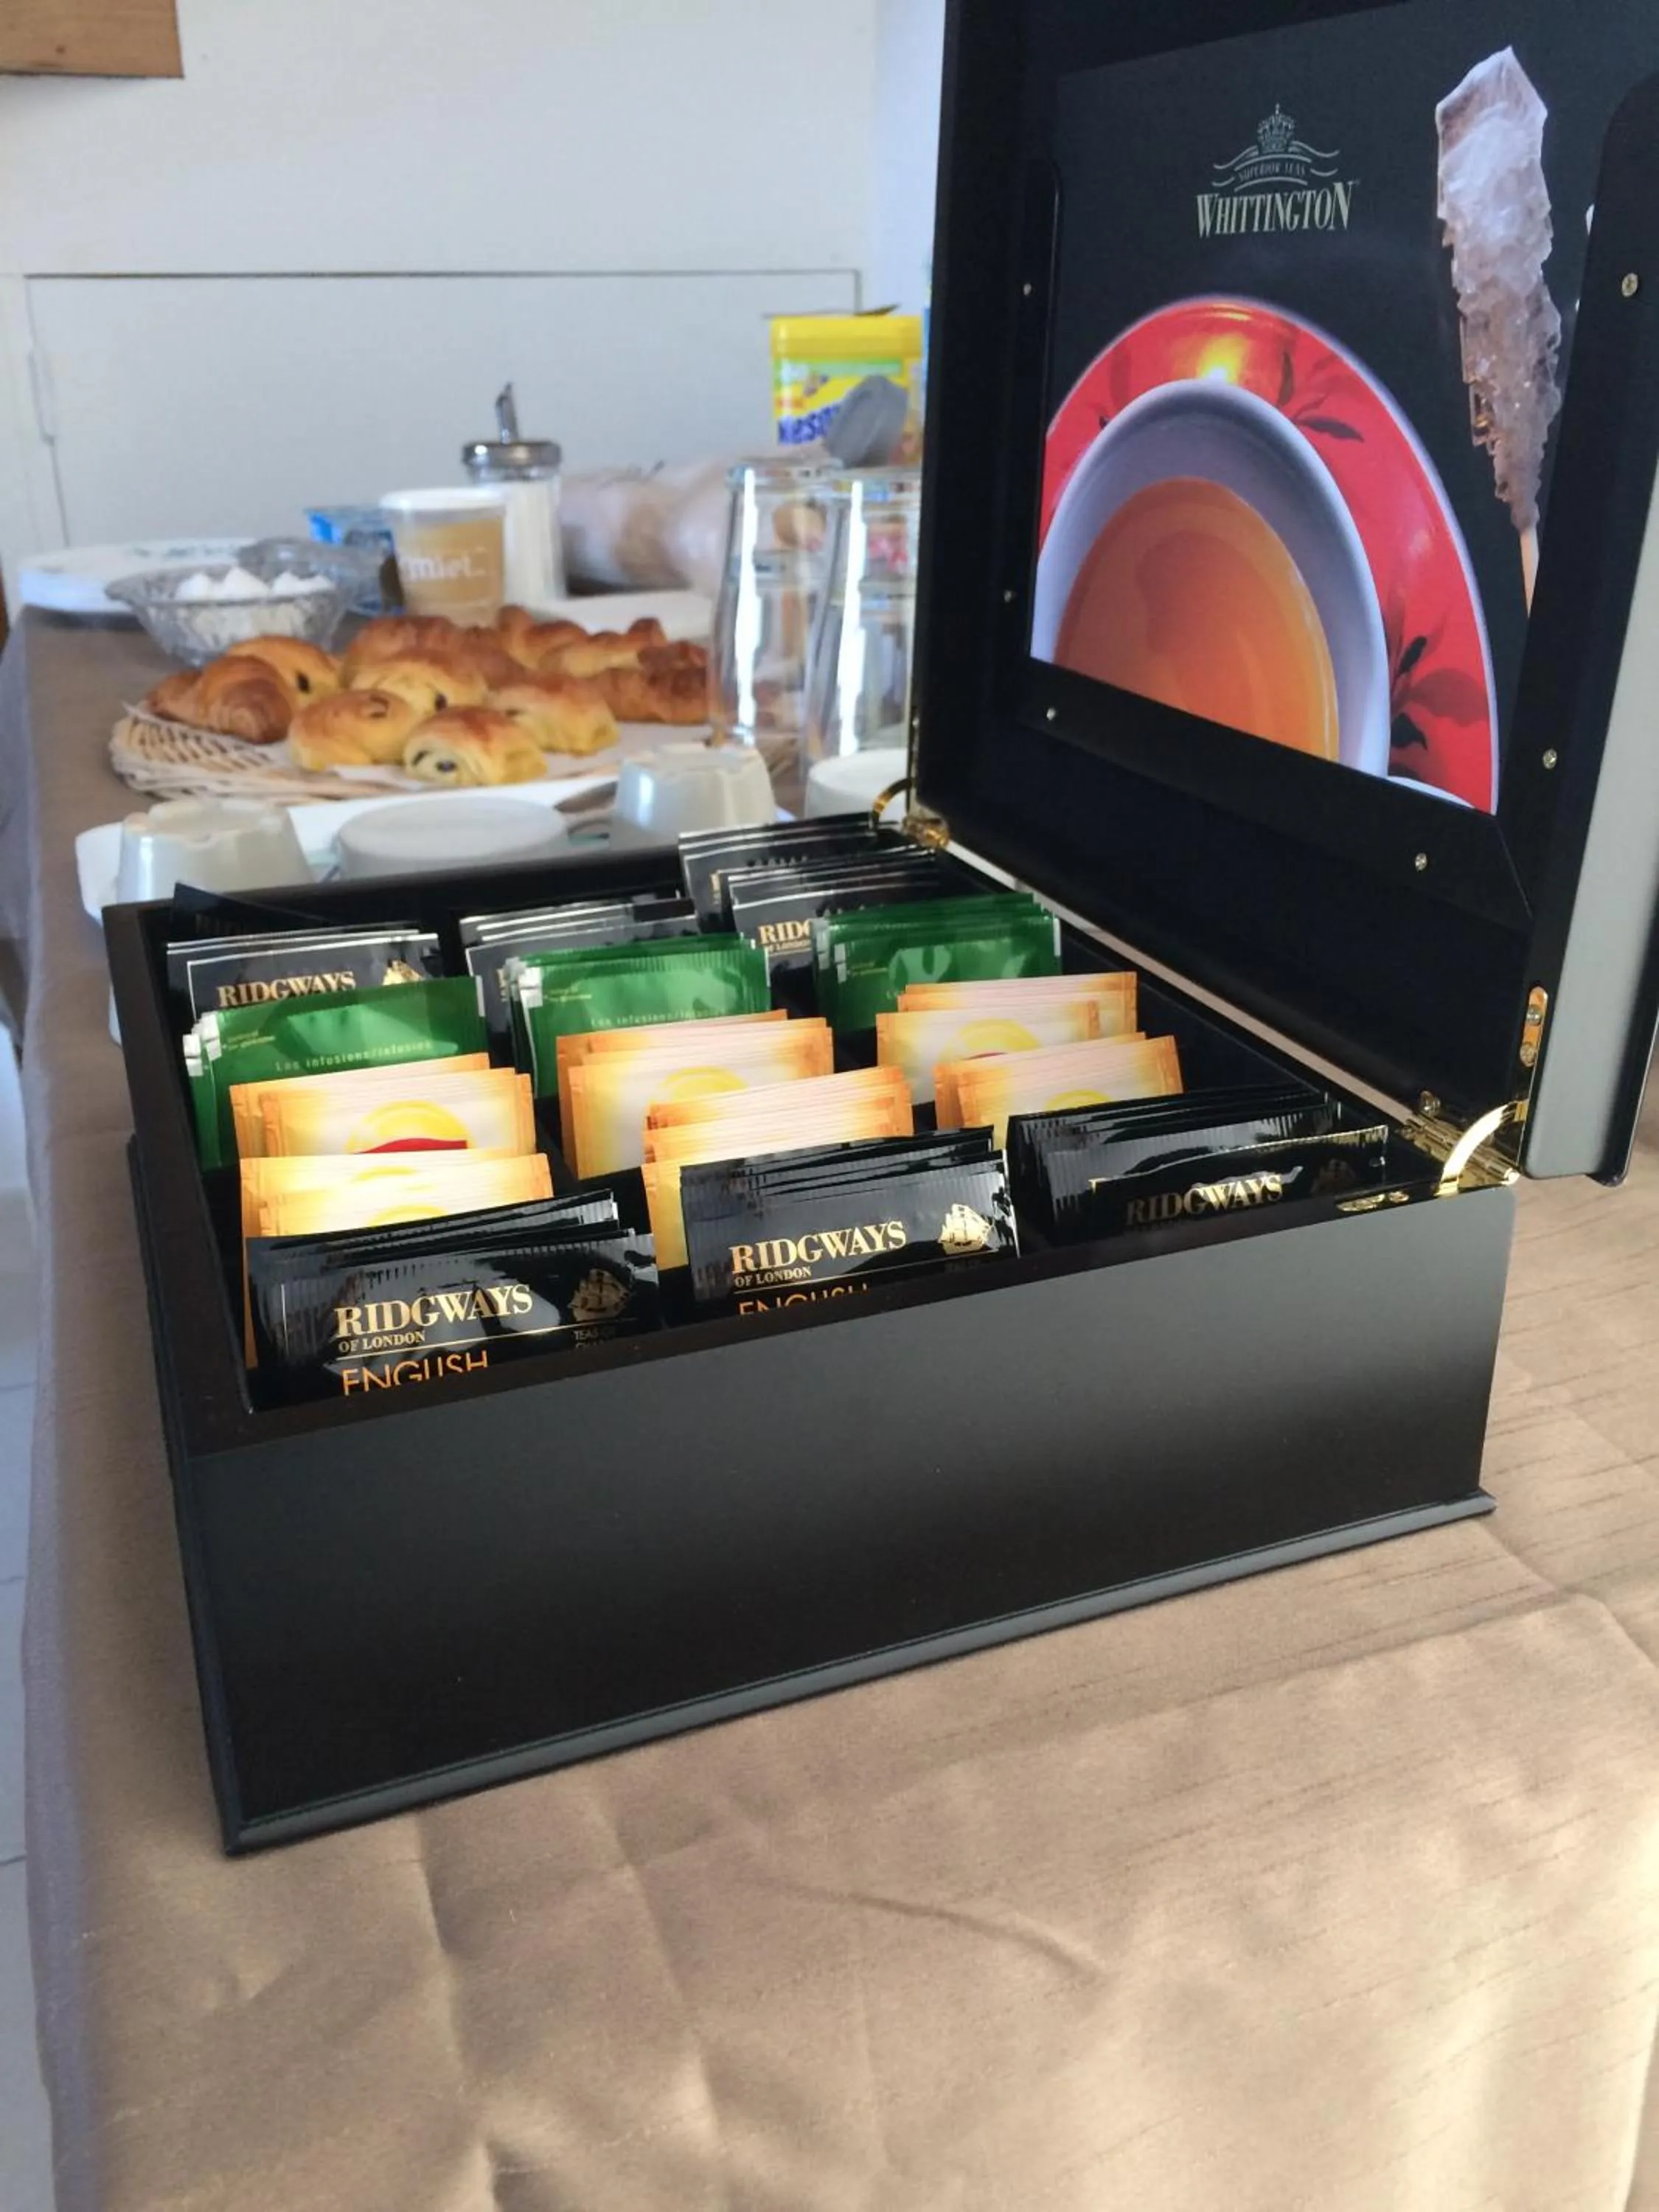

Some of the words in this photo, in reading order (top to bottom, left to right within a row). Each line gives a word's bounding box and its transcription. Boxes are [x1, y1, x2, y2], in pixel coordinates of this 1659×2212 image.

[1196, 181, 1354, 238] WHITTINGTON
[216, 970, 357, 1007] RIDGWAYS
[1126, 1173, 1283, 1225] RIDGWAYS
[728, 1220, 908, 1274] RIDGWAYS
[734, 1275, 751, 1288] OF
[756, 1266, 812, 1284] LONDON
[333, 1284, 534, 1339] RIDGWAYS
[338, 1338, 358, 1354] OF
[362, 1329, 426, 1351] LONDON
